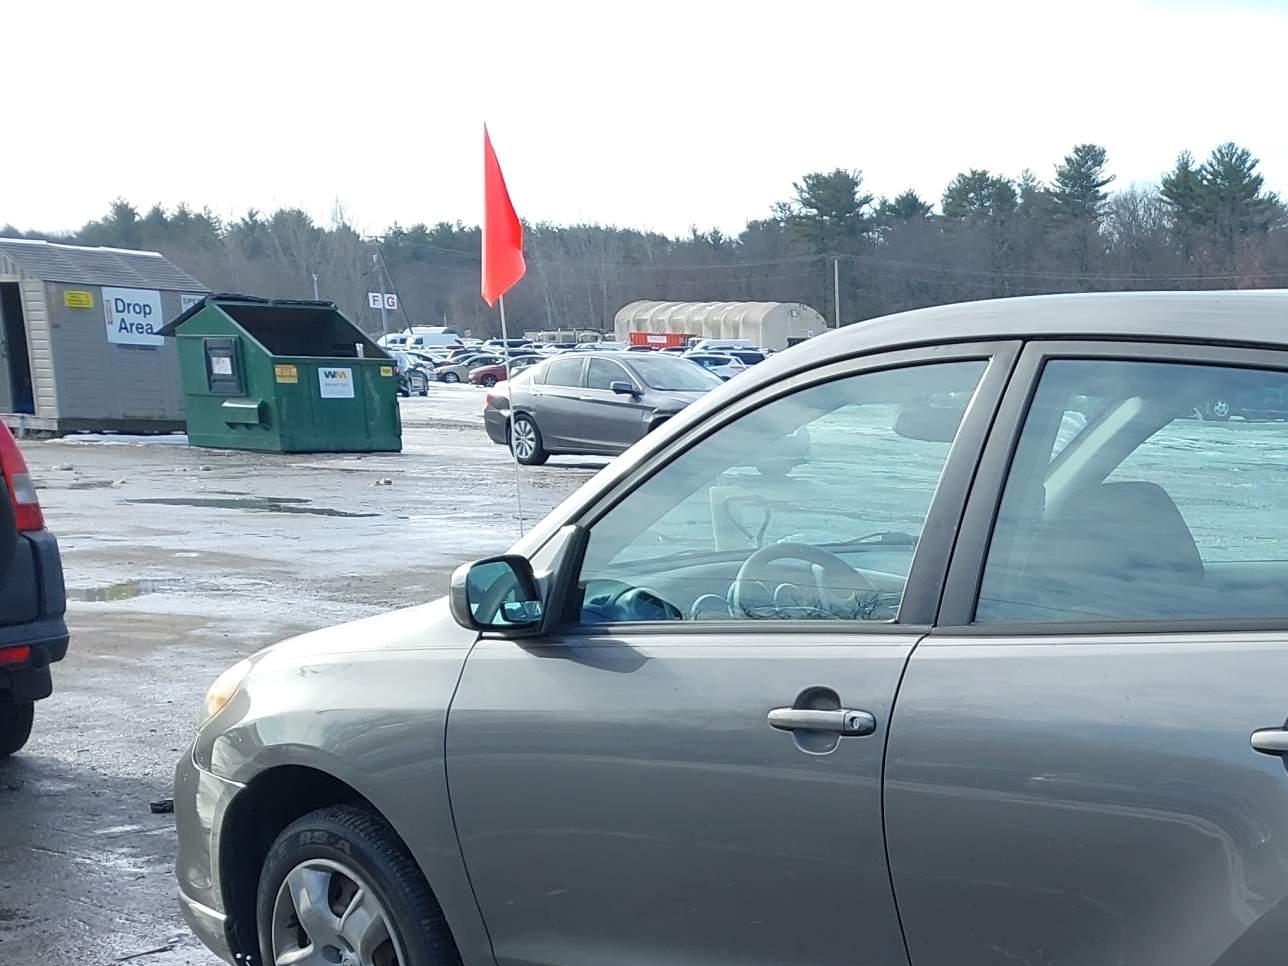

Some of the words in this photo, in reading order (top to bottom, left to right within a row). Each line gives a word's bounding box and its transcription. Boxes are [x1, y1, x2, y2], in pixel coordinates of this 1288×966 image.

[372, 295, 379, 306] F
[386, 296, 395, 307] G
[114, 297, 152, 318] Drop
[118, 318, 153, 334] Area
[324, 370, 347, 379] WM
